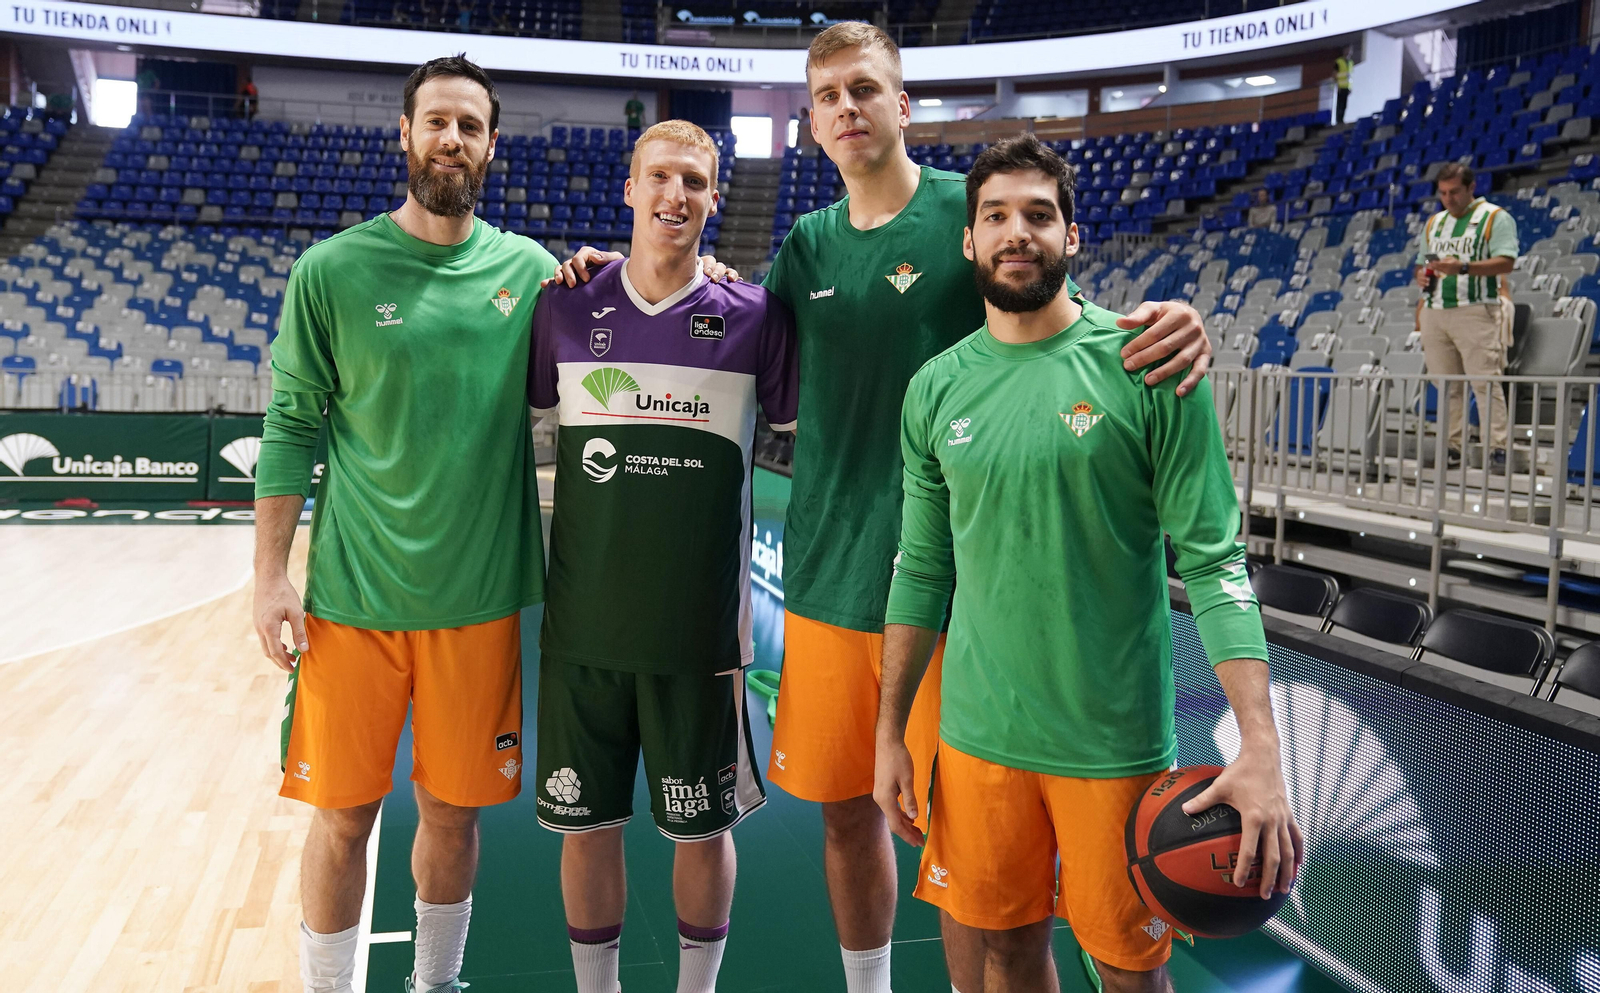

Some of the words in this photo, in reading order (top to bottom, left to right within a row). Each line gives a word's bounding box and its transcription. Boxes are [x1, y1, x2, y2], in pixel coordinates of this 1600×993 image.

[12, 6, 35, 24] TU
[43, 9, 109, 31] TIENDA
[116, 16, 172, 35] ONLI
[1182, 31, 1202, 49] TU
[1209, 21, 1269, 46] TIENDA
[1275, 9, 1328, 36] ONLI
[620, 53, 639, 68] TU
[645, 54, 701, 72] TIENDA
[706, 56, 754, 73] ONLI
[810, 286, 835, 300] hummel
[375, 317, 403, 327] hummel
[694, 320, 708, 330] liga
[693, 329, 723, 337] endesa
[635, 392, 711, 418] Unicaja
[947, 434, 973, 446] hummel
[52, 454, 133, 478] Unicaja
[135, 457, 199, 475] Banco
[625, 454, 660, 466] COSTA
[661, 457, 682, 467] DEL
[684, 458, 704, 469] SOL
[624, 463, 669, 476] MÁLAGA
[498, 738, 513, 749] acb
[661, 775, 684, 785] sabor
[721, 772, 734, 782] acb
[1151, 772, 1185, 797] liga
[663, 793, 711, 818] laga
